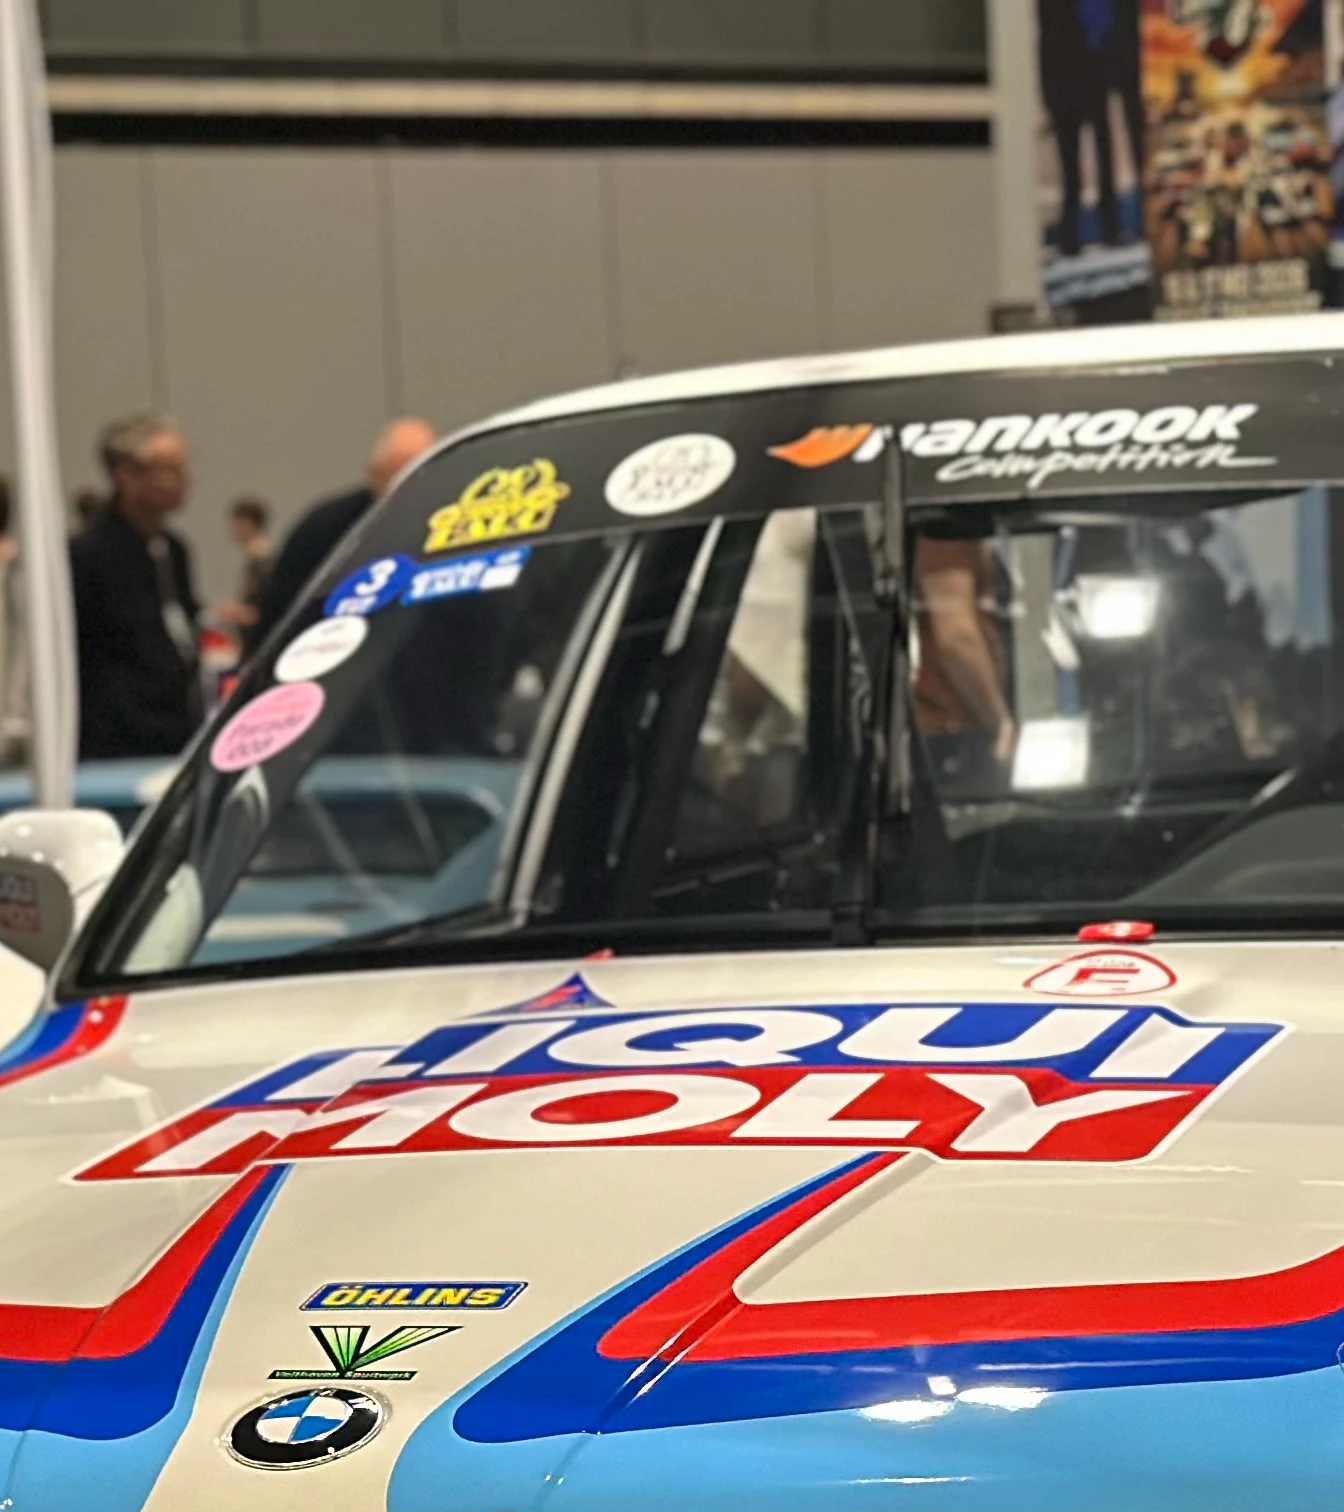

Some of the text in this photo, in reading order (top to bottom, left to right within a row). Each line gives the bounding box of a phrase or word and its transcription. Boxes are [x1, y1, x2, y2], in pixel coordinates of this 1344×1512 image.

[936, 442, 1278, 490] Competition
[265, 1008, 1231, 1102] LIQUI
[136, 1072, 1189, 1176] MOLY
[320, 1284, 505, 1307] ÖHLINS
